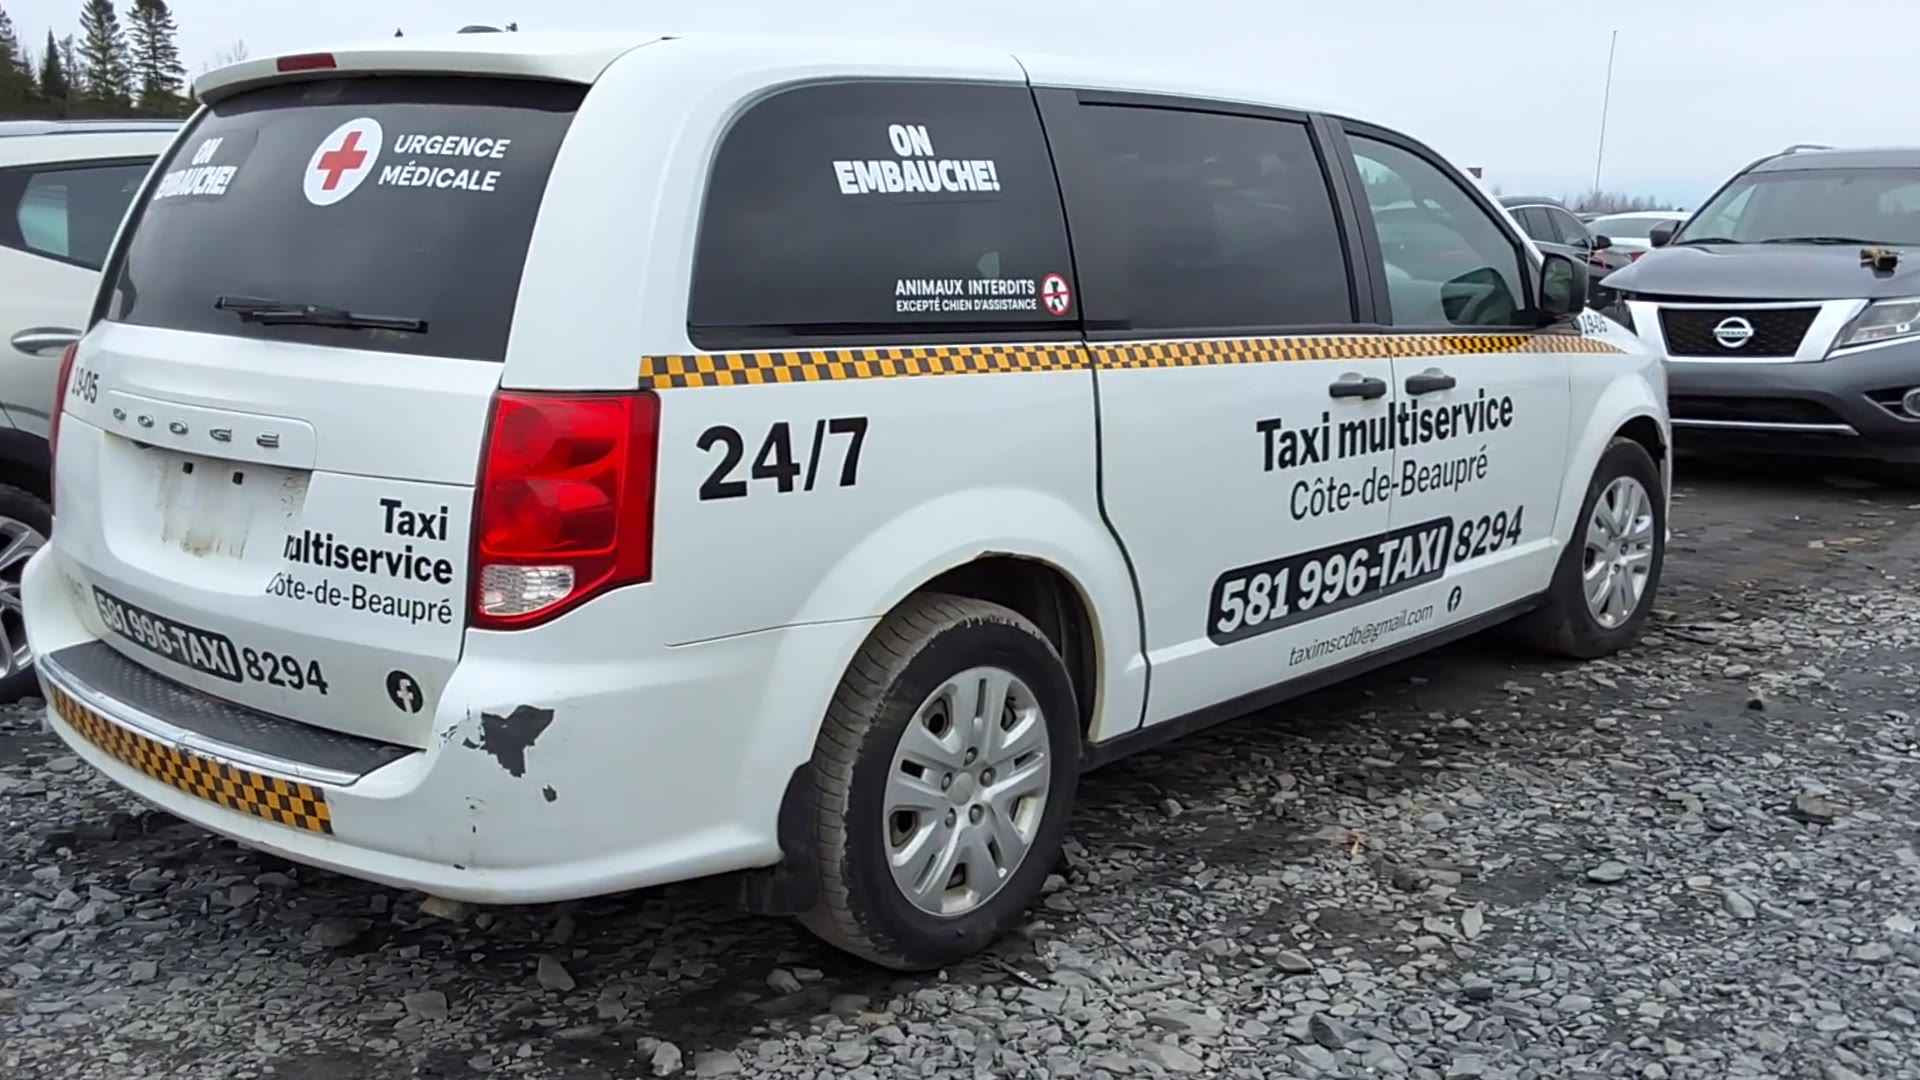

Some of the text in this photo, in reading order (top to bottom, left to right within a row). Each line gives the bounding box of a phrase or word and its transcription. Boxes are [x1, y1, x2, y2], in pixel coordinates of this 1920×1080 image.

[394, 134, 511, 158] URGENCE
[889, 124, 934, 157] ON
[378, 160, 501, 191] MÉDICALE
[833, 160, 1000, 194] EMBAUCHE!
[896, 279, 1035, 296] ANIMAUX INTERDITS
[896, 297, 1037, 312] EXCEPTÉ CHIEN D'ASSISTANCE
[1256, 388, 1513, 472] Taxi multiservice
[696, 416, 868, 500] 24/7
[1290, 444, 1488, 520] Côte-de-Beaupré
[380, 498, 448, 541] Taxi
[1217, 568, 1289, 633] 581
[1299, 526, 1448, 611] 996-TAXI
[1454, 505, 1523, 563] 8294
[97, 592, 131, 635] 581
[242, 647, 329, 696] 8294
[1289, 604, 1433, 666] taximscdb@gmail.com
